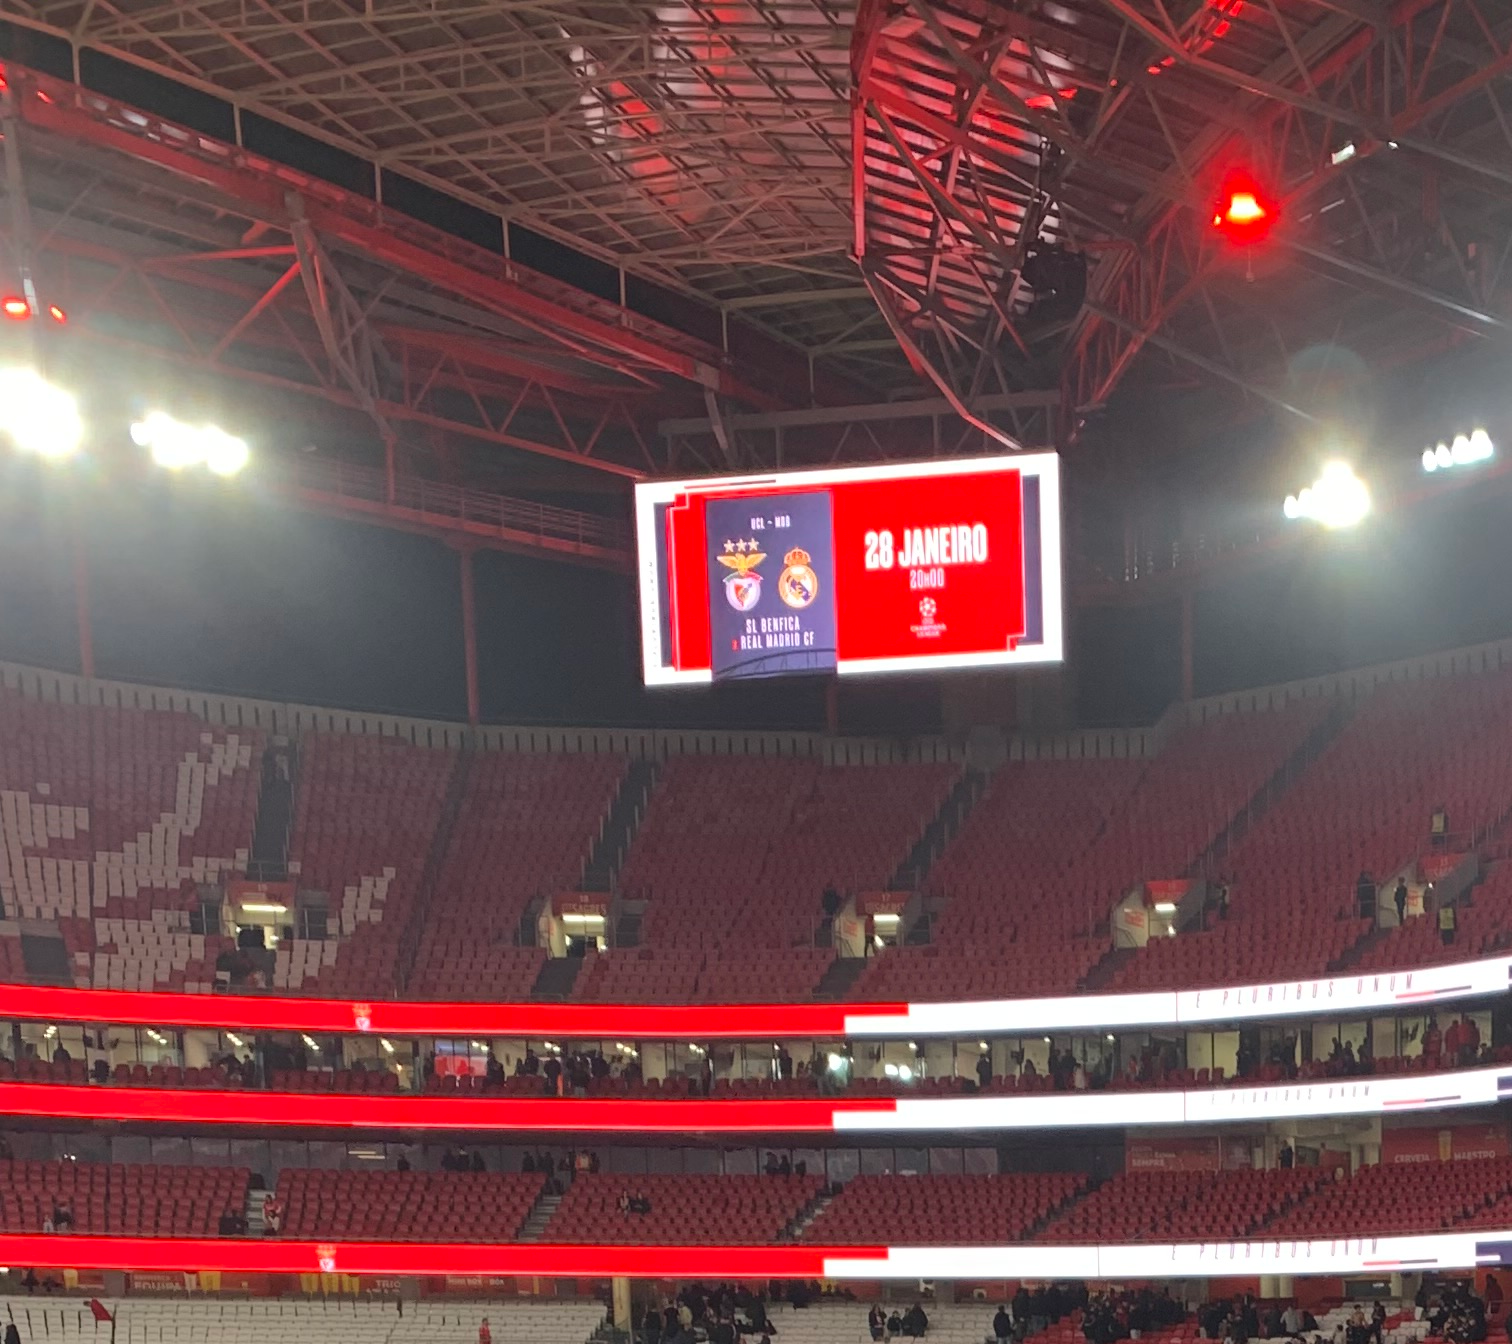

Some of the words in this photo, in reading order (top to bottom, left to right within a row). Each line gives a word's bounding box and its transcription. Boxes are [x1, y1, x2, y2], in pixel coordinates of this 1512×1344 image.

[864, 530, 894, 569] 28
[898, 523, 988, 567] JANEIRO
[745, 618, 758, 634] SL
[761, 616, 801, 632] BENFICA
[740, 634, 763, 650] REAL
[766, 631, 800, 648] MADRID
[803, 631, 815, 646] CF
[1222, 981, 1334, 1005] PLURIBUS
[1357, 974, 1413, 994] UNUM
